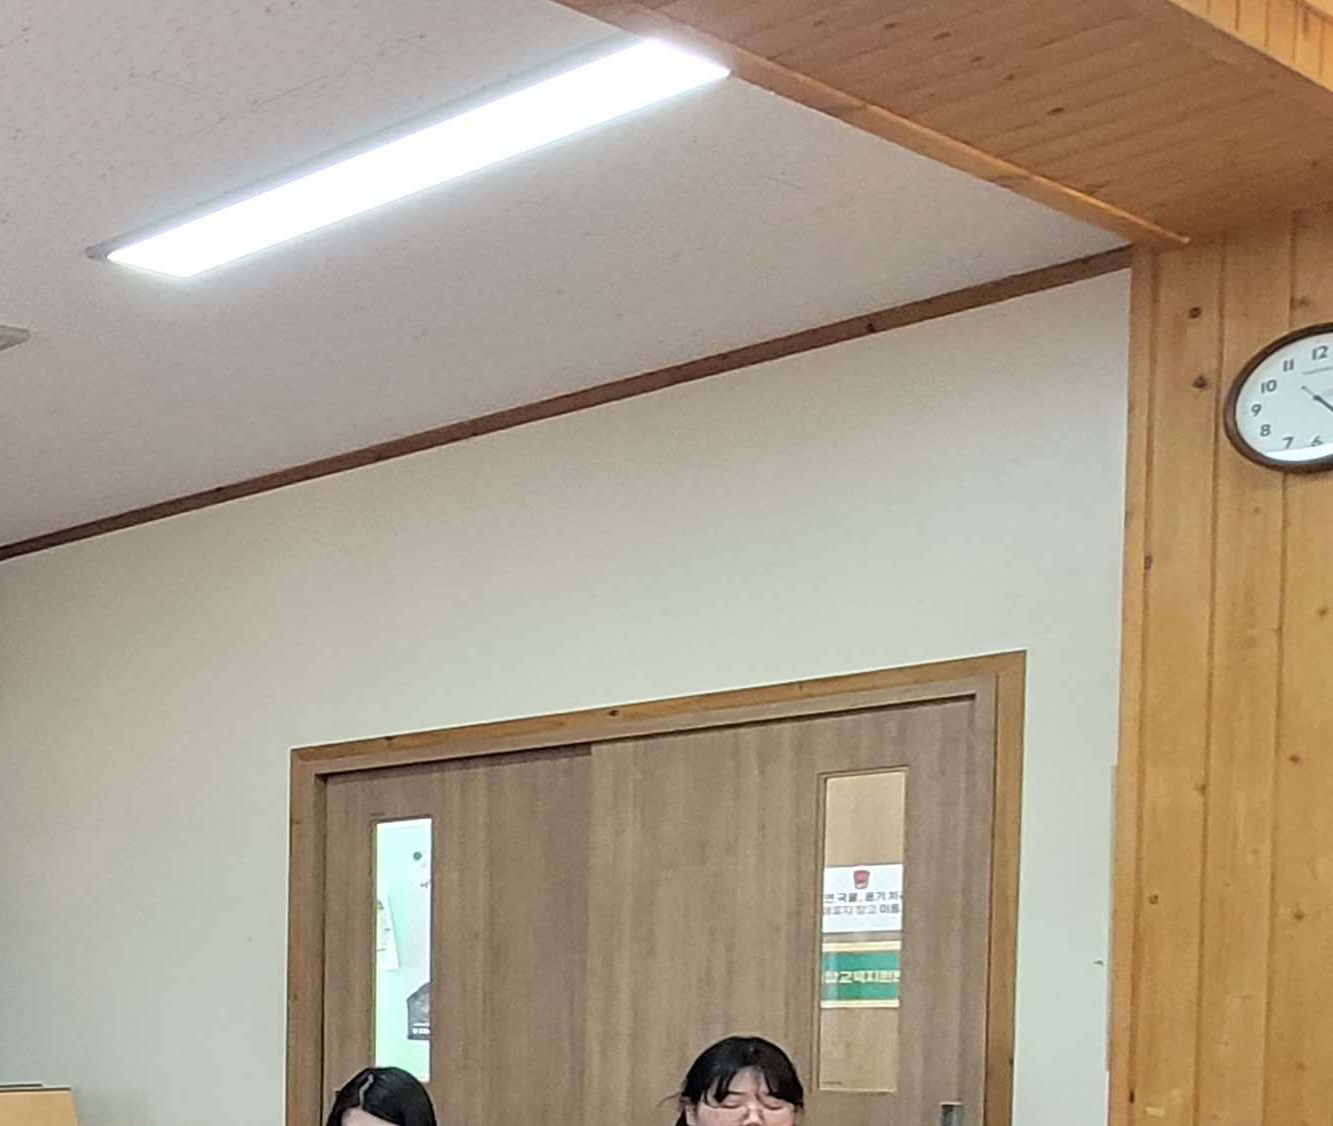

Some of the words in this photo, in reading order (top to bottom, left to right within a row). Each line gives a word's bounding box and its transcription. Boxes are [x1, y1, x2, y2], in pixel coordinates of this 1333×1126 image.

[1312, 345, 1329, 361] 12
[1283, 359, 1295, 372] 11
[1261, 379, 1278, 394] 10
[1251, 403, 1263, 417] 9
[1260, 424, 1272, 437] 8
[1283, 436, 1294, 450] 7
